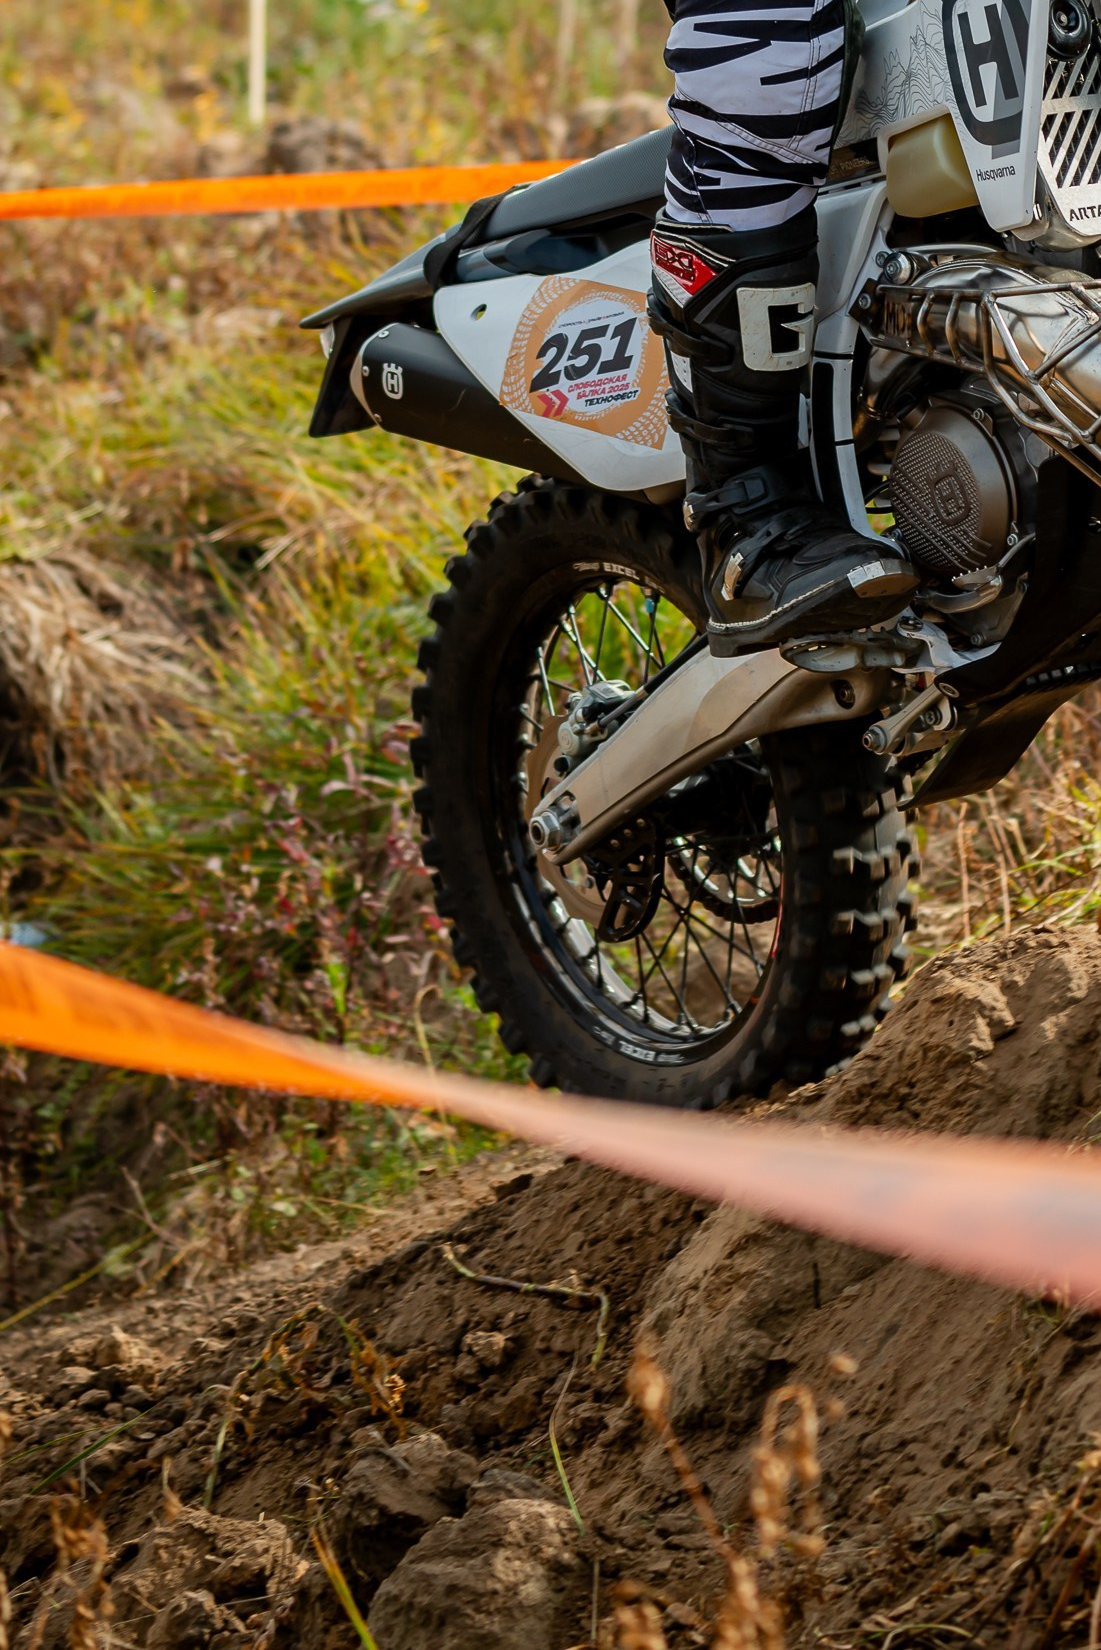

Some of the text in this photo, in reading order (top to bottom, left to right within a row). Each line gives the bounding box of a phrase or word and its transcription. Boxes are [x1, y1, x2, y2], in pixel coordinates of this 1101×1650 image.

[975, 164, 1016, 183] Husqvarna
[528, 316, 638, 394] 251
[568, 374, 628, 393] СЛОБОДСКАЯ
[576, 382, 630, 401] БАЛКА 2025
[584, 389, 639, 407] ТЕХНОФЕСТ
